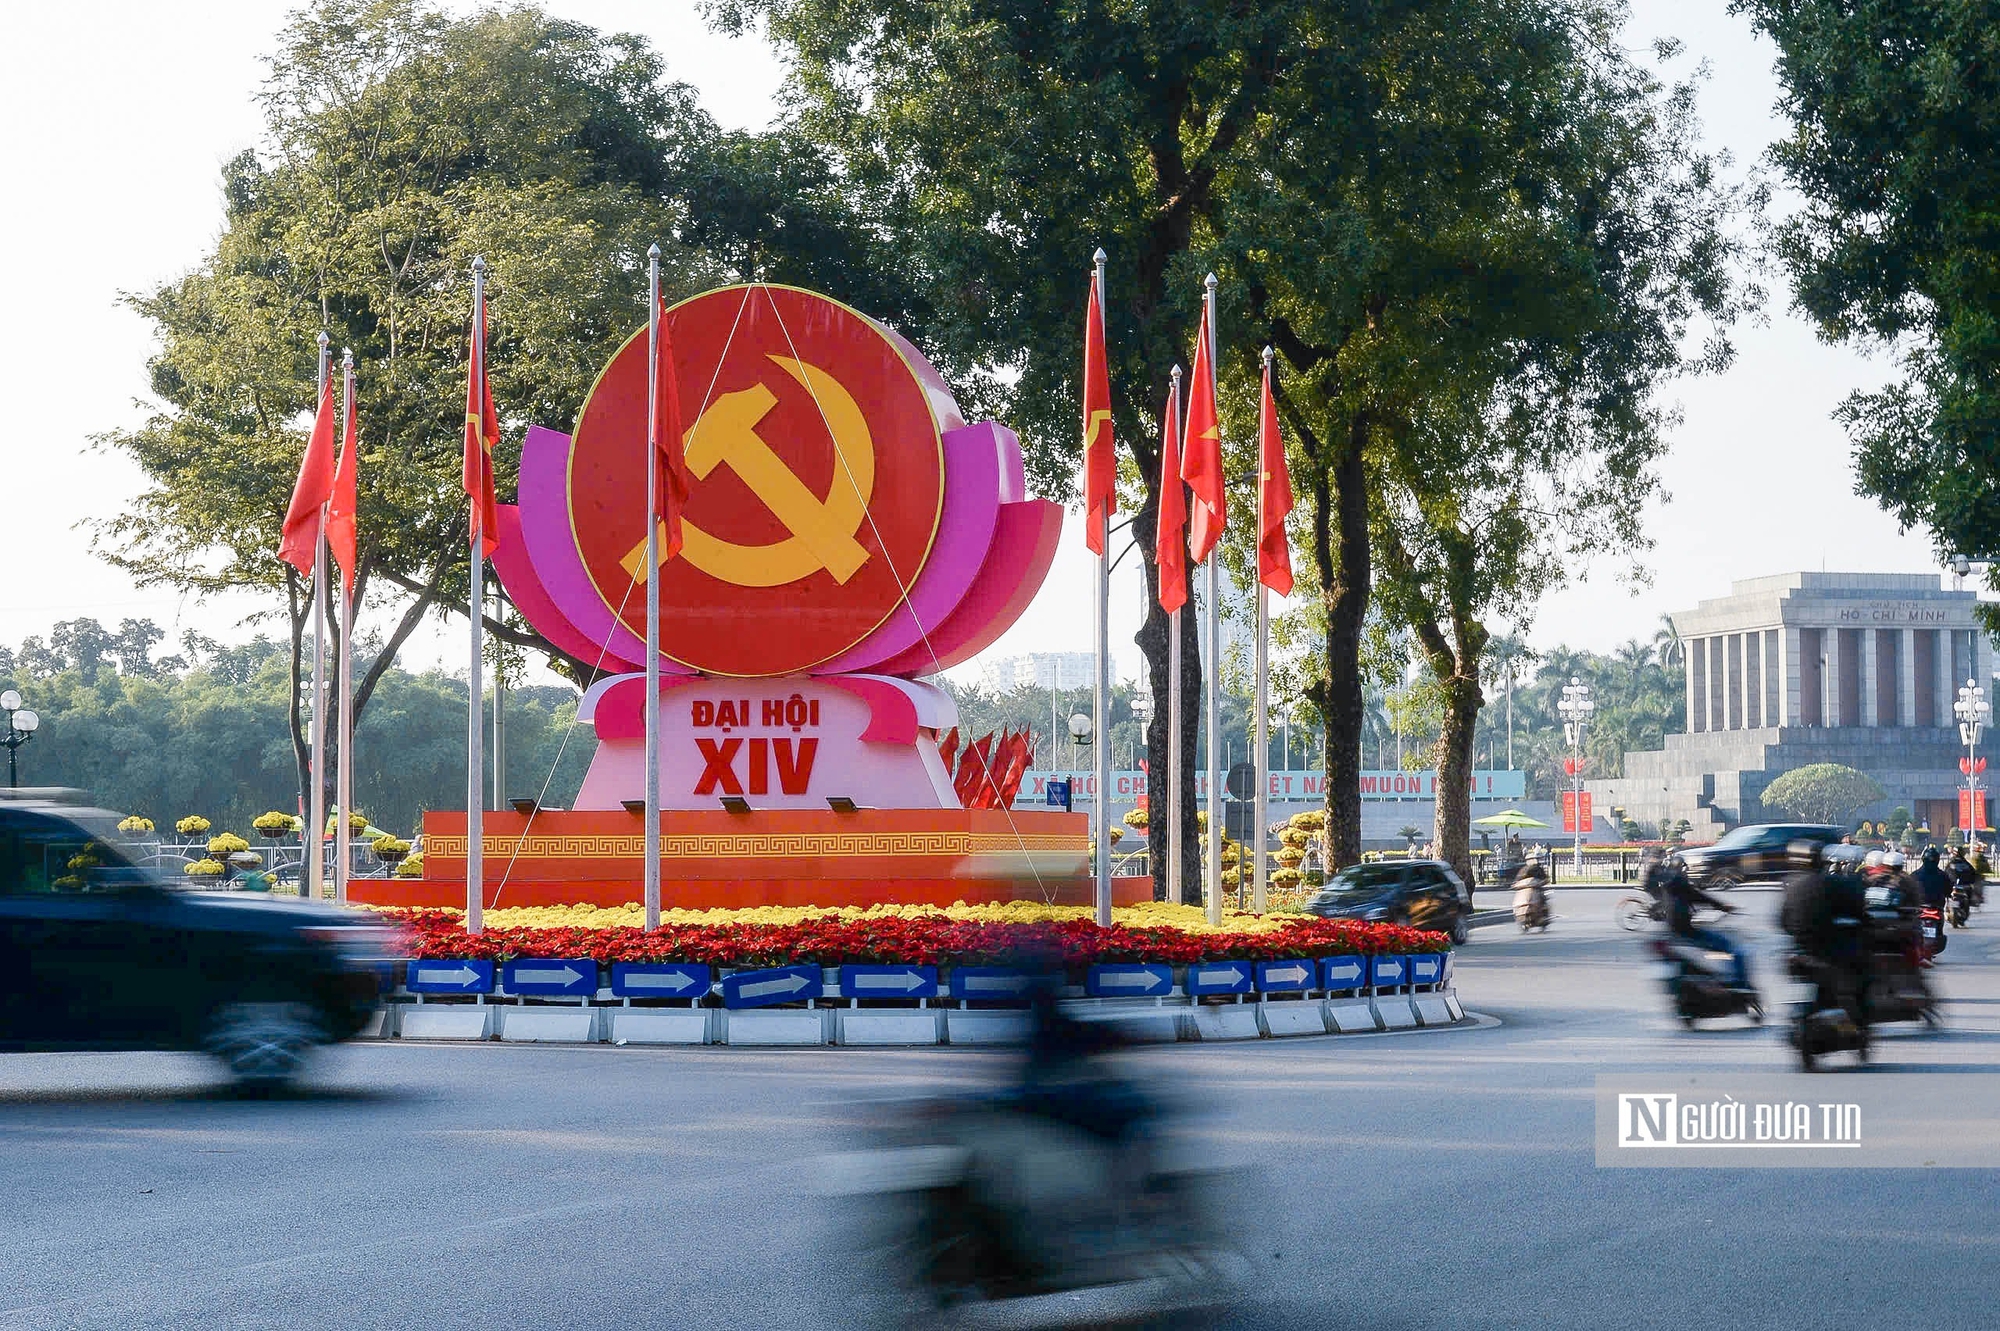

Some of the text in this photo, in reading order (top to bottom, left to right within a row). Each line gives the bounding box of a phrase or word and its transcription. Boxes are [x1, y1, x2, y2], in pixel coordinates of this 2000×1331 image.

[1908, 607, 1945, 621] MINH
[691, 694, 820, 733] ĐẠI HỘI
[693, 738, 820, 796] XIV
[1117, 776, 1146, 795] CH
[1360, 773, 1421, 794] MUÔN
